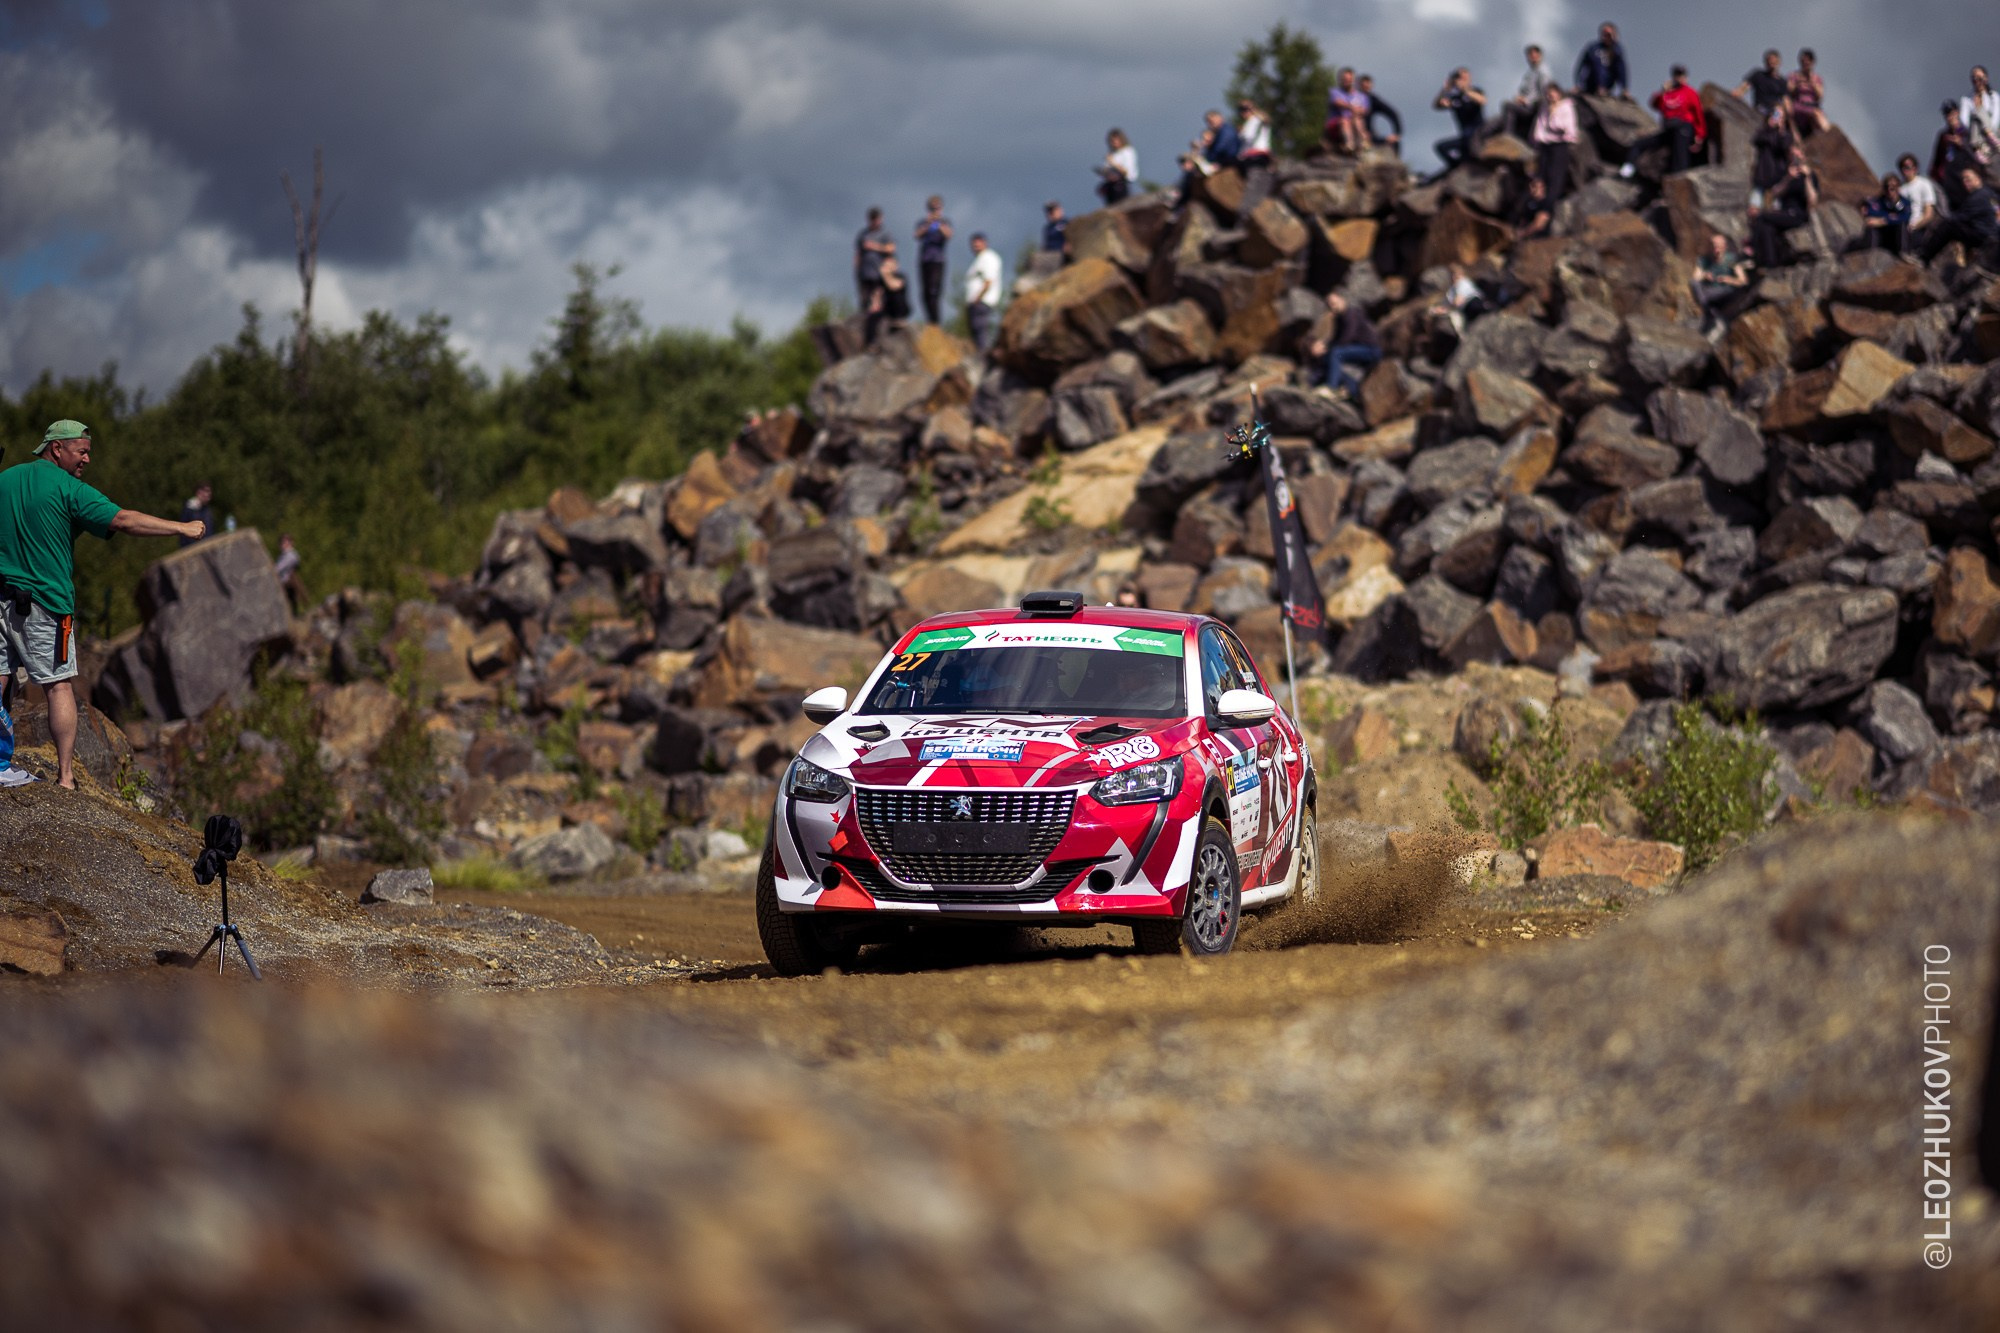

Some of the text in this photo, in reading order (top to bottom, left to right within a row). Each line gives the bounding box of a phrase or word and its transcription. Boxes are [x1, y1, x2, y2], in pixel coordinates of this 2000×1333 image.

[1001, 636, 1102, 644] ТАТНЕФТЬ
[891, 653, 932, 672] 27
[925, 745, 1020, 754] БЕЛЫЕ НОЧИ
